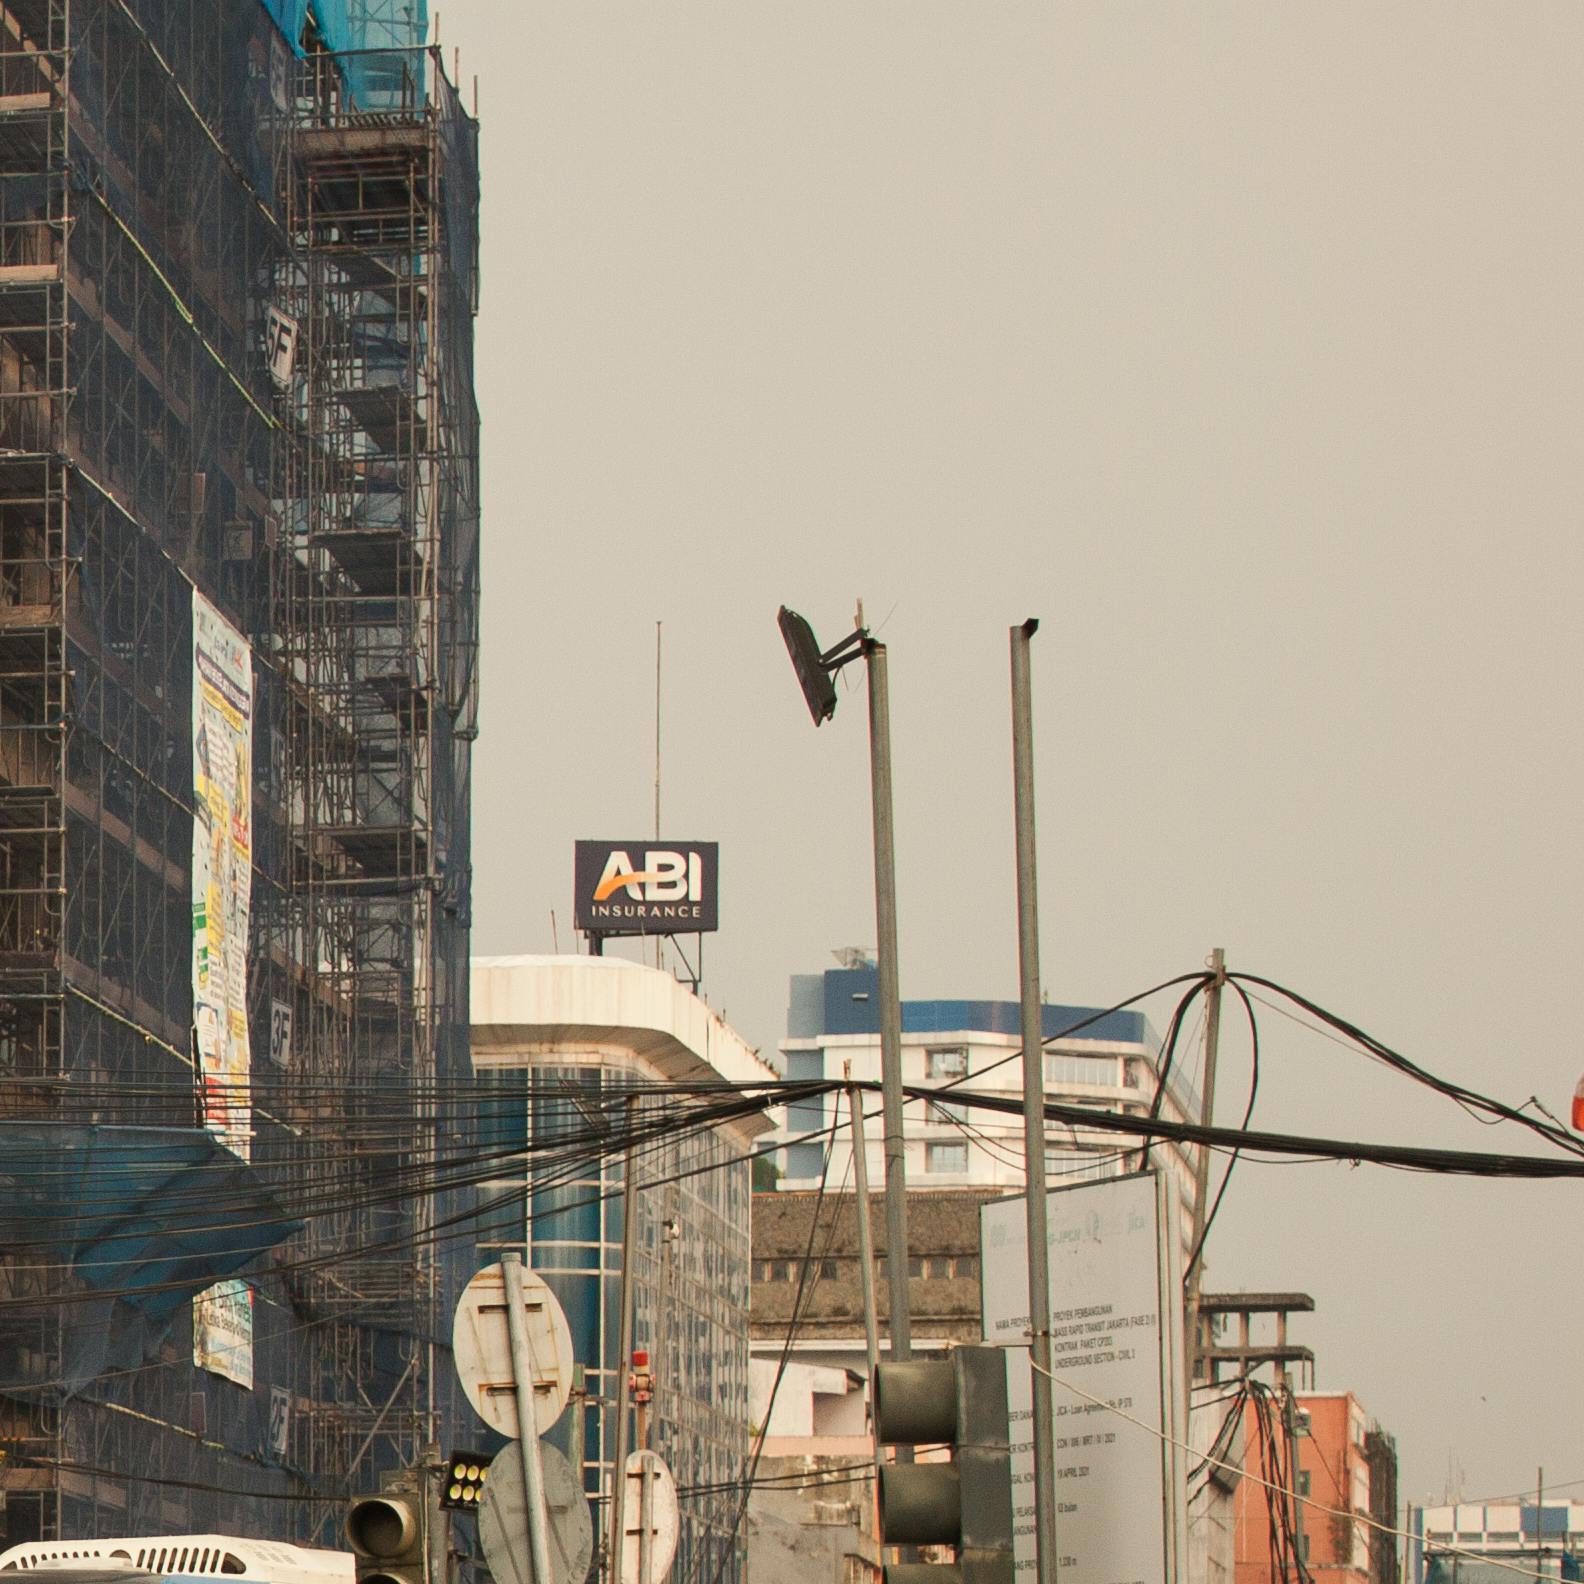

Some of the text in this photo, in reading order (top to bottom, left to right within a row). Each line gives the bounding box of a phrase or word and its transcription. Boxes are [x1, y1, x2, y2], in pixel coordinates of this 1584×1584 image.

[593, 851, 702, 902] ABI
[591, 905, 702, 919] INSURANCE
[273, 1009, 290, 1058] 3F
